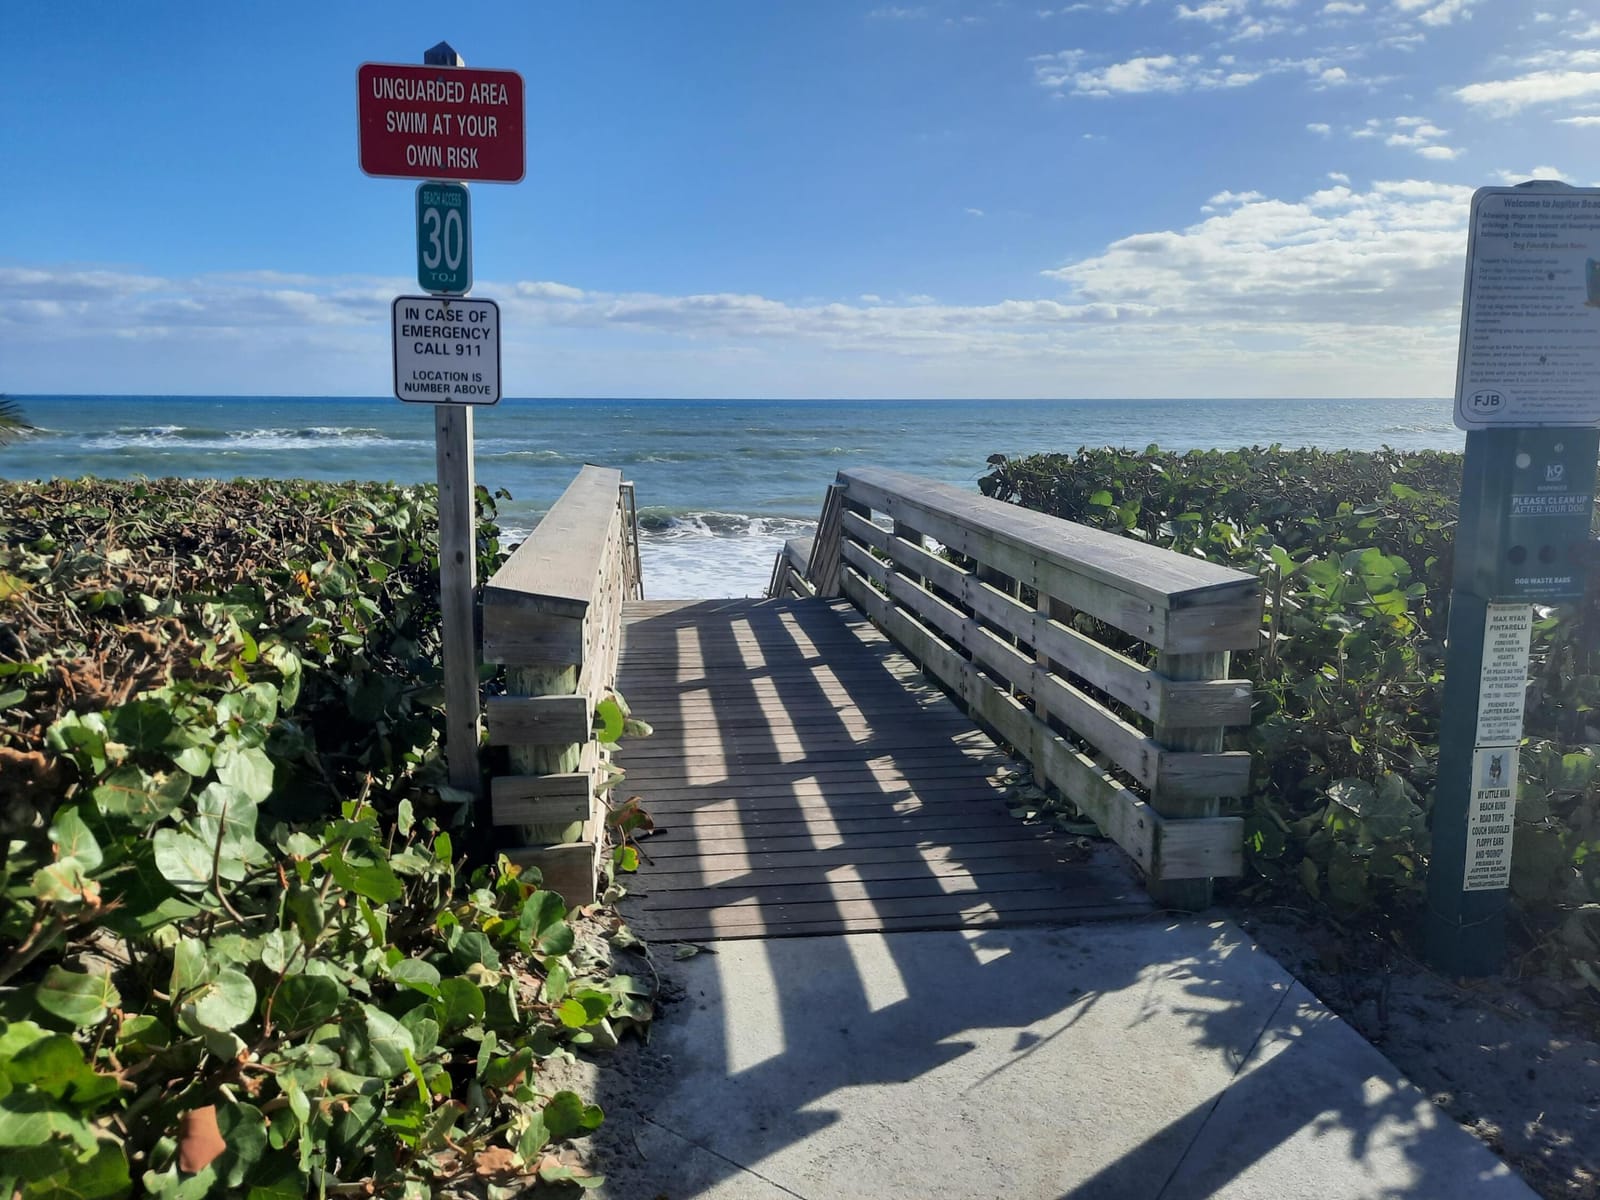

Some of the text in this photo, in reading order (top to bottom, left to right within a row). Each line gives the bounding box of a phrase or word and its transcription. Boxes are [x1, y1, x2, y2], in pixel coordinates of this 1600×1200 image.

[372, 77, 508, 105] UNGUARDED AREA
[386, 110, 497, 138] SWIM AT YOUR
[406, 144, 478, 168] OWN RISK
[424, 191, 462, 206] BEACH ACCESS
[1504, 199, 1541, 208] Welcome
[1543, 200, 1551, 208] to
[1552, 200, 1579, 210] Jupiter
[423, 208, 463, 270] 30
[431, 272, 456, 282] TOJ
[405, 307, 488, 323] IN CASE OF
[402, 325, 490, 340] EMERGENCY
[414, 342, 481, 356] CALL 911
[413, 370, 482, 382] LOCATION IS
[404, 382, 490, 395] NUMBER ABOVE
[1474, 395, 1500, 406] FJB
[1512, 495, 1588, 505] PLEASE CLEAN UP
[1514, 504, 1585, 513] AFTER YOUR DOG
[1485, 790, 1499, 799] LITTLE
[1480, 802, 1494, 811] BEACH
[1492, 813, 1504, 822] TRIPS
[1472, 827, 1487, 835] COUCH
[1476, 837, 1504, 847] FLOPPY EARS
